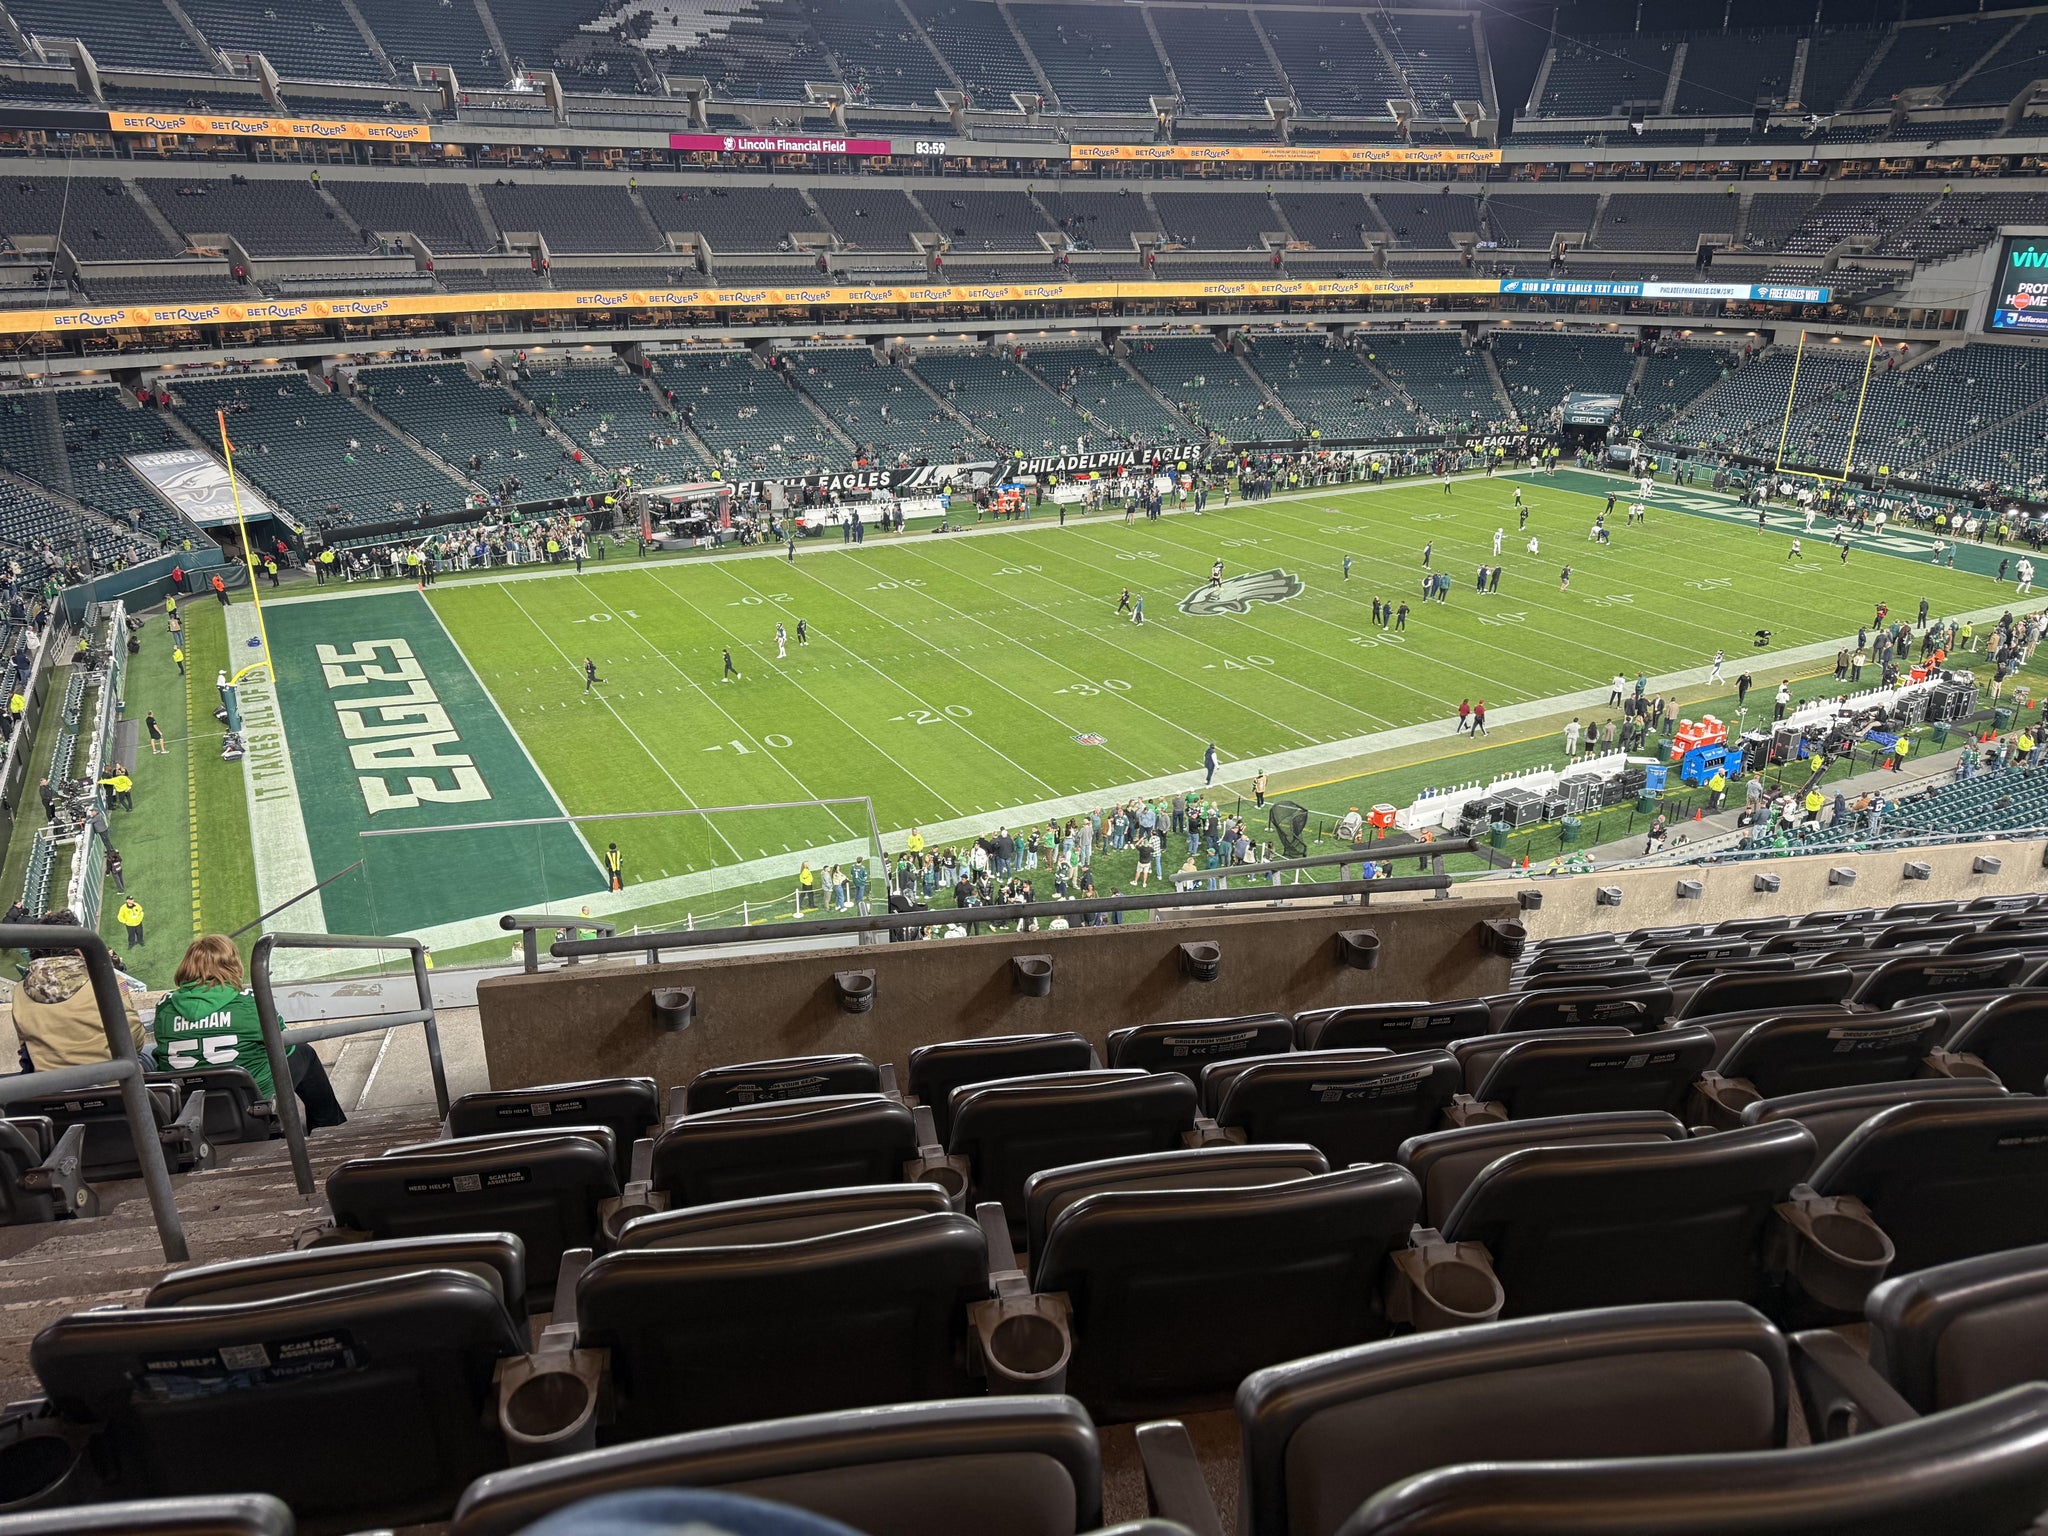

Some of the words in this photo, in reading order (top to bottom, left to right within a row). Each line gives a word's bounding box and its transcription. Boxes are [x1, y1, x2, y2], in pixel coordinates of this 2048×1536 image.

[738, 138, 775, 150] Lincoln
[777, 139, 821, 151] Financial
[823, 140, 846, 152] Field
[916, 142, 946, 155] 83:59
[1540, 282, 1550, 292] UP
[1552, 283, 1566, 292] FOR
[1568, 284, 1592, 292] EAGLES
[1594, 284, 1612, 293] TEXT
[1612, 284, 1639, 294] ALERTS
[1572, 416, 1604, 424] GEICO
[1466, 439, 1481, 447] FLY
[1530, 437, 1546, 446] FLY
[1018, 451, 1135, 475] PHILADELPHIA
[1142, 445, 1200, 463] EAGLES
[818, 471, 891, 490] EAGLES
[1348, 632, 1406, 648] 50
[1222, 655, 1276, 672] 40
[240, 688, 270, 704] OF
[1070, 678, 1132, 697] 30
[244, 706, 277, 728] ALL
[907, 704, 973, 726] 20
[315, 638, 493, 816] EAGLES
[728, 734, 793, 756] 10
[248, 733, 286, 780] TAKES
[254, 786, 290, 802] IT
[173, 1012, 231, 1032] GRAHAM
[168, 1034, 240, 1070] 55
[1401, 1072, 1420, 1080] SEAT
[279, 1342, 343, 1360] ASSISTANCE
[280, 1341, 311, 1352] SCAN
[314, 1337, 336, 1347] FOR
